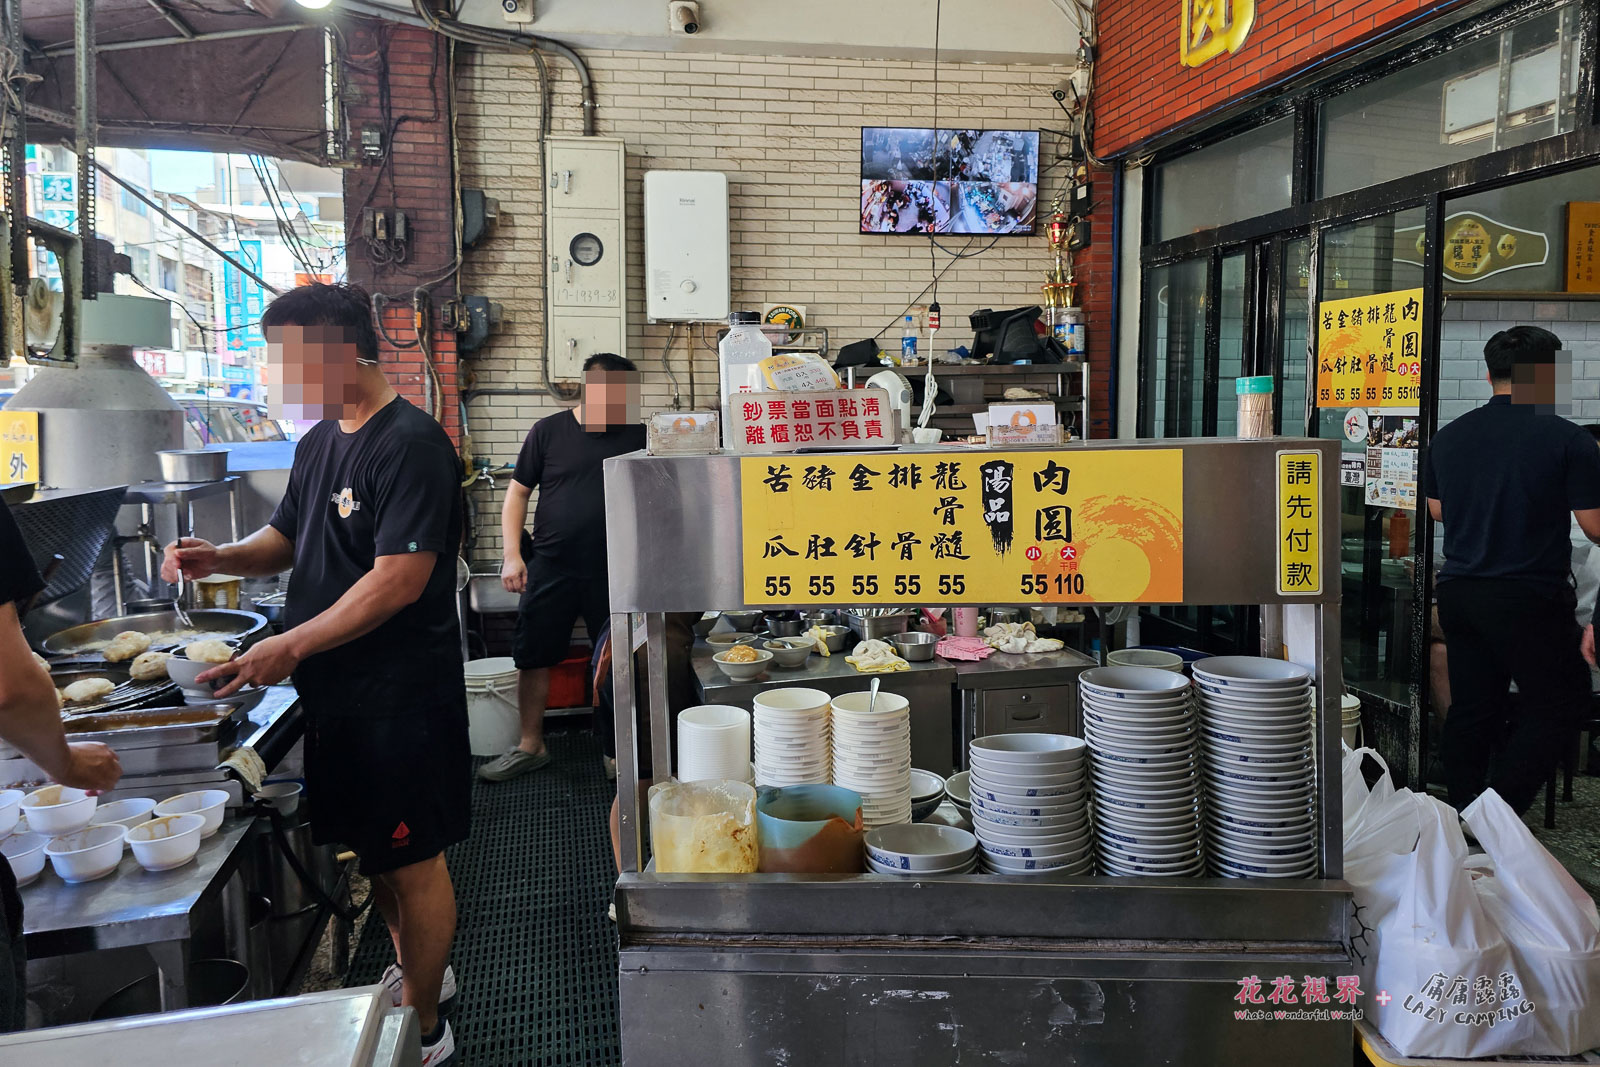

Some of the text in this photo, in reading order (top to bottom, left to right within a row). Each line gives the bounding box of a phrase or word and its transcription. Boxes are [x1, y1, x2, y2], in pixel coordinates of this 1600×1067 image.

[768, 307, 799, 319] TAIWAN PORK
[1399, 363, 1419, 375] 小 大
[1320, 385, 1420, 401] 55 55 55 55 55 55 110
[742, 396, 880, 422] 鈔票當面點清
[745, 420, 884, 445] 離櫃恕不負責
[10, 453, 28, 479] 外
[985, 465, 1011, 523] 湯品
[1033, 460, 1072, 543] 肉圓
[762, 464, 799, 558] 苦瓜
[802, 464, 838, 560] 豬肚
[844, 463, 881, 561] 金針
[888, 462, 922, 561] 排骨
[930, 461, 971, 561] 龍骨髓
[1286, 460, 1312, 587] 請先付款
[1027, 547, 1075, 559] 小 大
[1060, 561, 1077, 571] 干貝
[765, 573, 1084, 596] 55 55 55 55 55 55 110
